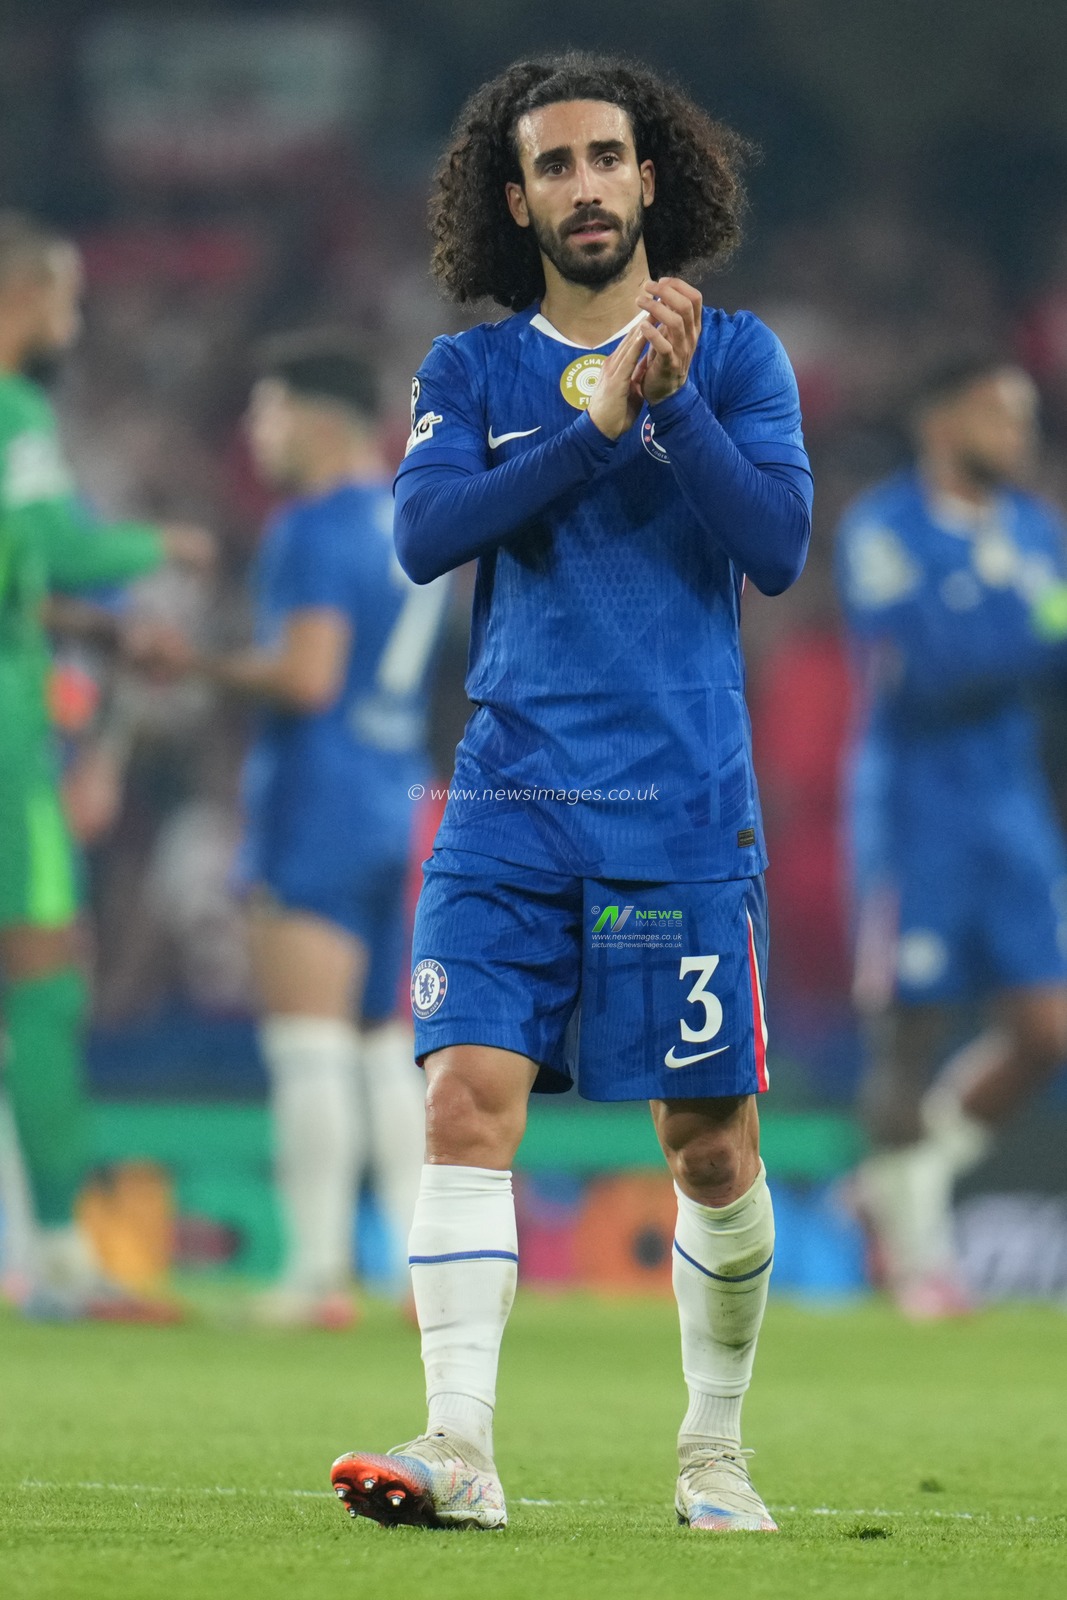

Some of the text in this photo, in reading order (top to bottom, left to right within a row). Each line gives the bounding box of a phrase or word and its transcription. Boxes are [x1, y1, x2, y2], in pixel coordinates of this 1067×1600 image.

[566, 358, 605, 389] WORLD CHA
[579, 396, 590, 405] FI
[414, 961, 439, 977] CHELSEA
[679, 954, 723, 1043] 3
